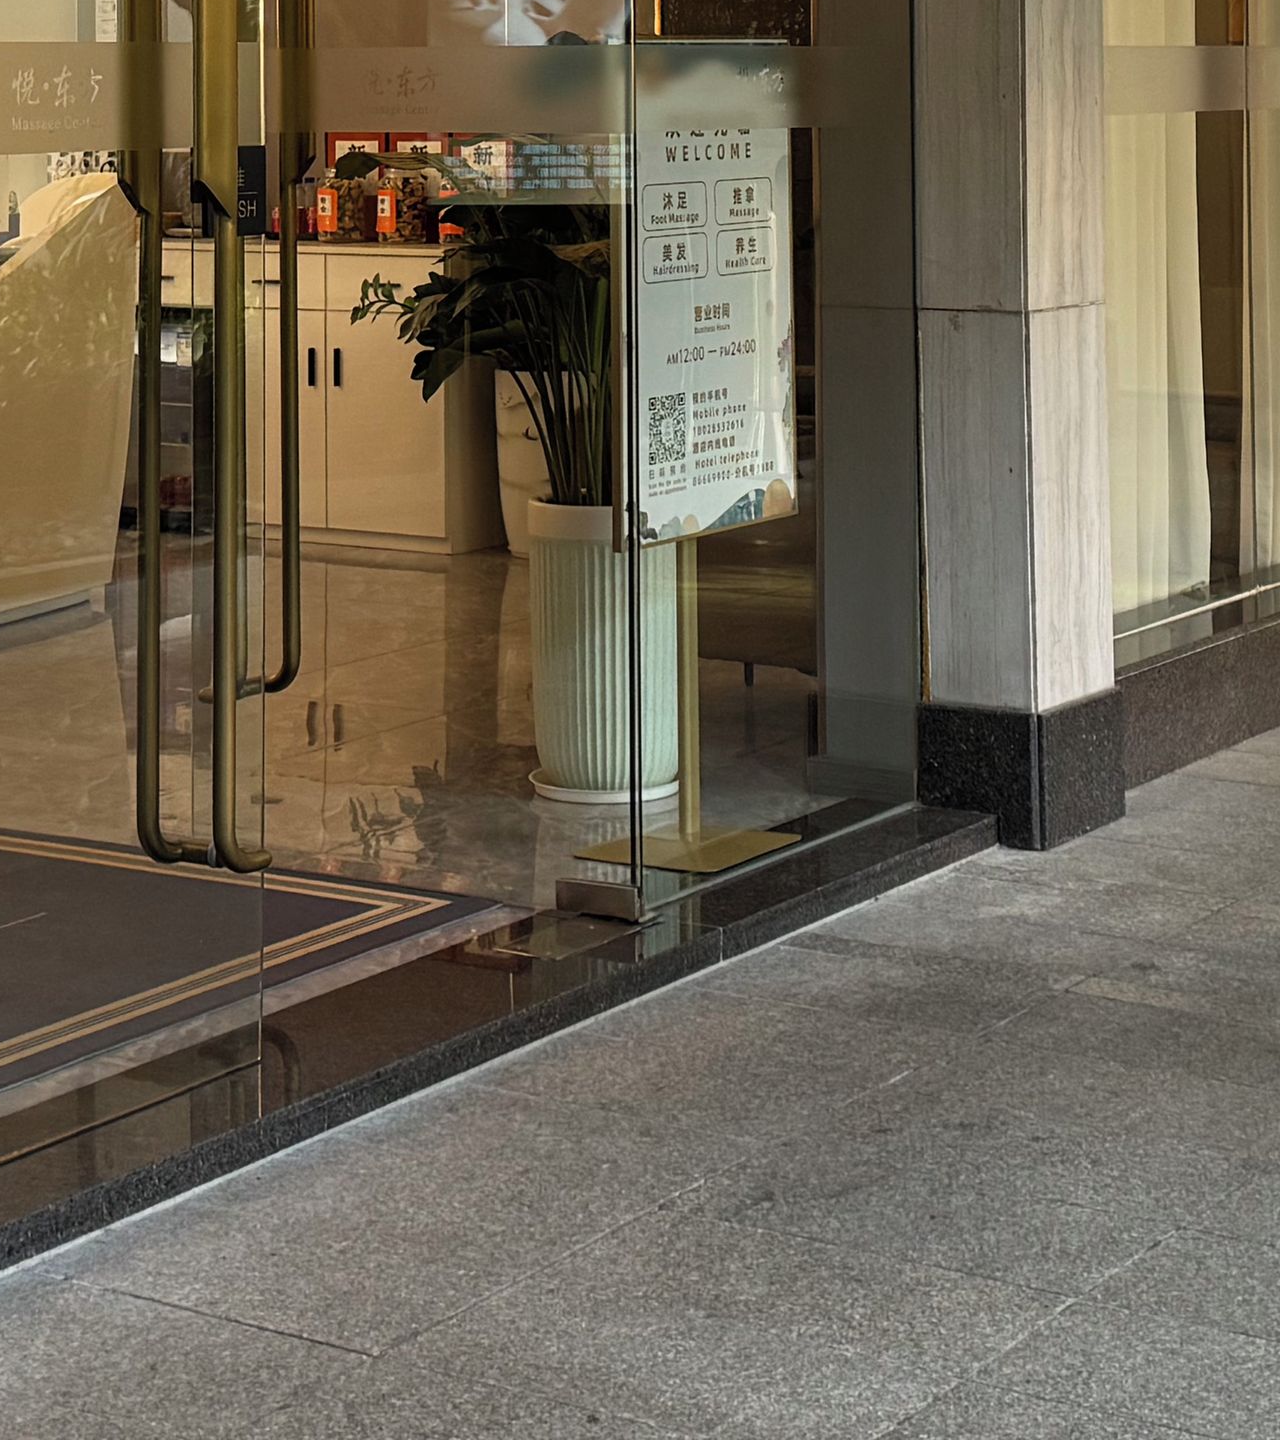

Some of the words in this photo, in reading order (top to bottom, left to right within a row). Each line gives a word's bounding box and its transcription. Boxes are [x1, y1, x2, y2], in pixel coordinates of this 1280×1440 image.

[665, 142, 752, 163] WELCOME
[662, 191, 688, 211] 沐足
[651, 214, 668, 225] Foot
[668, 212, 699, 224] Massage
[729, 208, 760, 218] Massage
[662, 242, 687, 262] 美发
[735, 236, 757, 255] 养生
[693, 302, 731, 322] 营业时间
[666, 346, 705, 365] AM12:00
